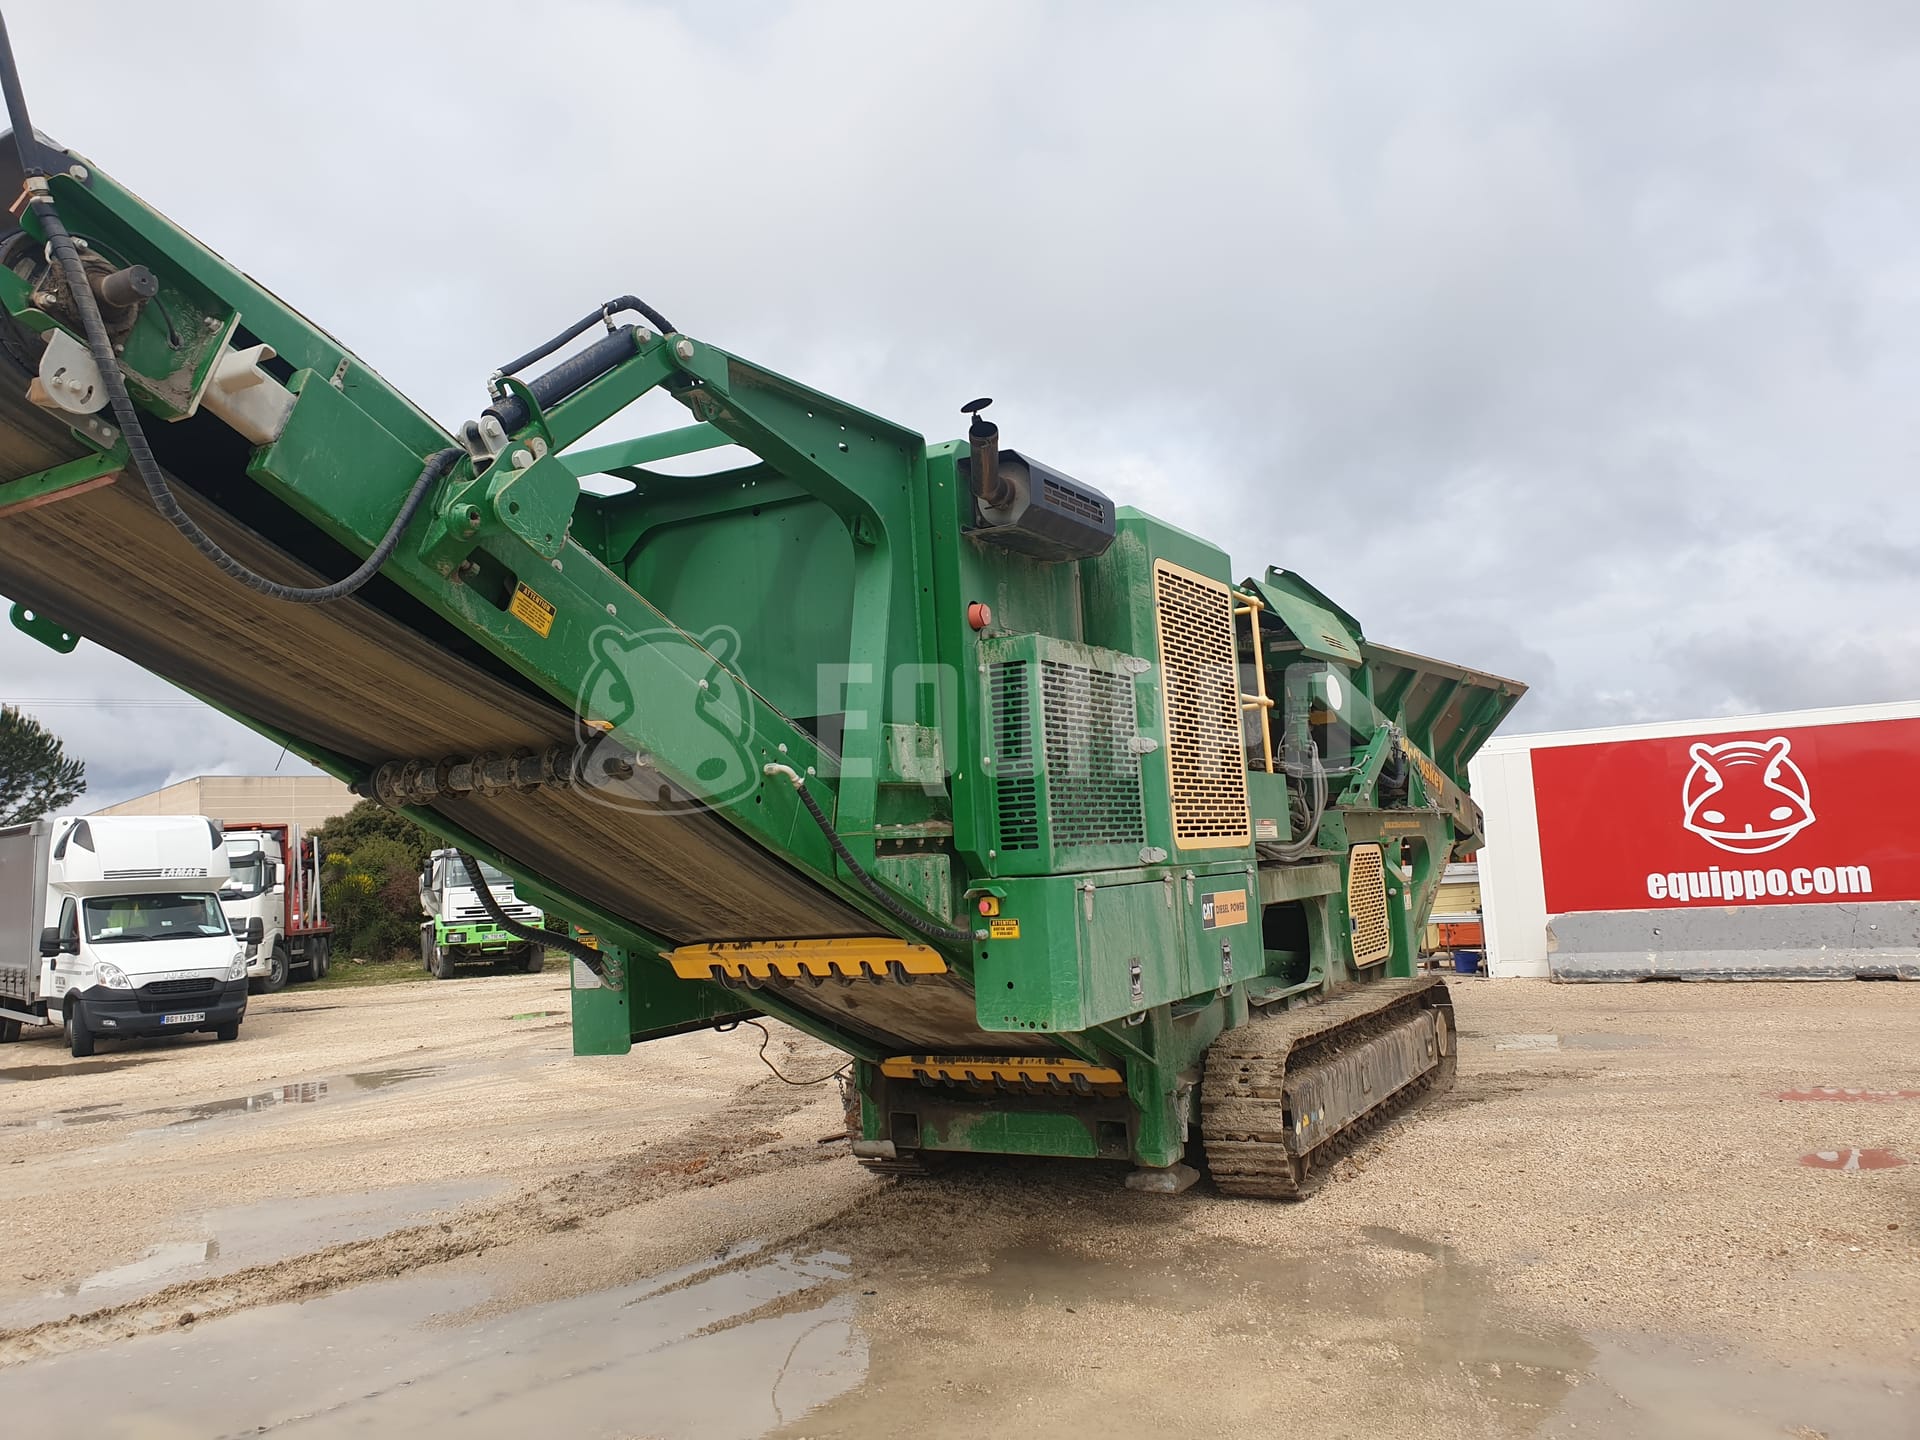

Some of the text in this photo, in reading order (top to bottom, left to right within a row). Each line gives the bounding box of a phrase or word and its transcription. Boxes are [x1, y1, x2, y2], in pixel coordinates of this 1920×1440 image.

[523, 587, 551, 612] ATTENTION
[160, 868, 201, 878] LAMAR
[1647, 865, 1873, 902] equippo.com
[1203, 902, 1245, 920] CAT DIESEL POWER
[163, 971, 200, 980] IVECO
